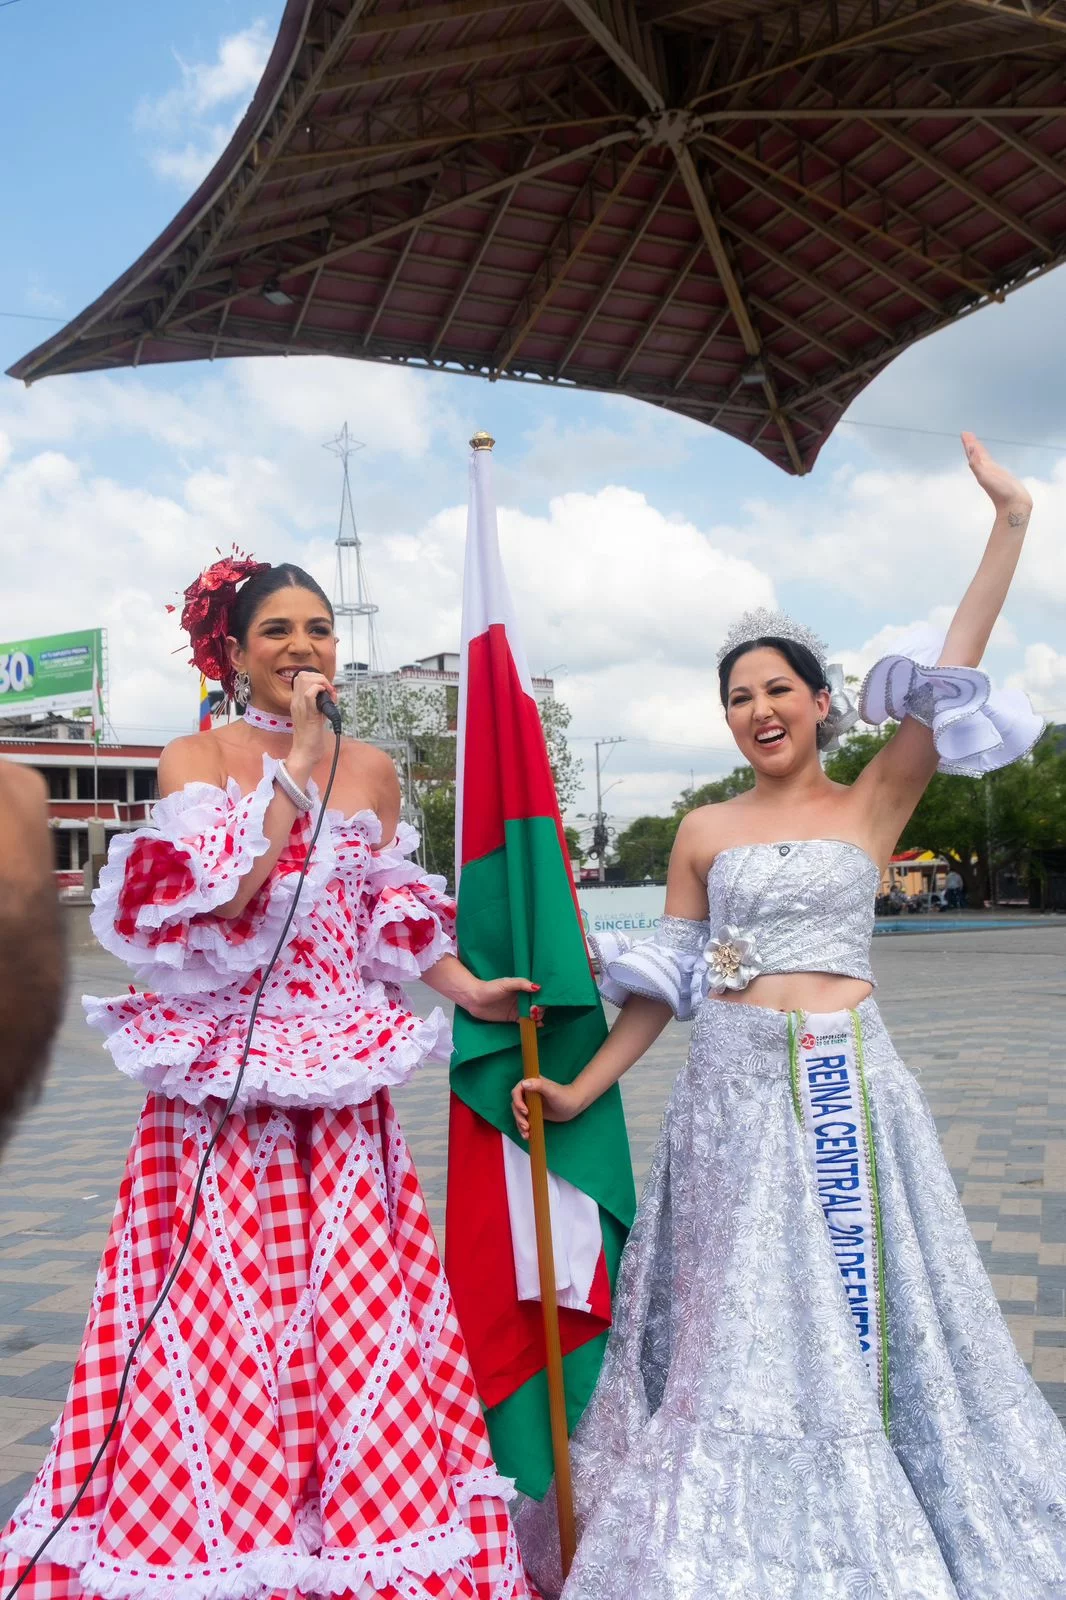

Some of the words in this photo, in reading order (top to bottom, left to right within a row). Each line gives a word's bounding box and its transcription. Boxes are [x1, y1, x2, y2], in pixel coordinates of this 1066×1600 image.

[594, 918, 660, 931] SINCELEJO
[801, 1035, 816, 1047] 20
[805, 1054, 852, 1119] REINA
[814, 1121, 862, 1219] CENTRAL
[828, 1224, 864, 1247] 20
[835, 1252, 866, 1280] DE
